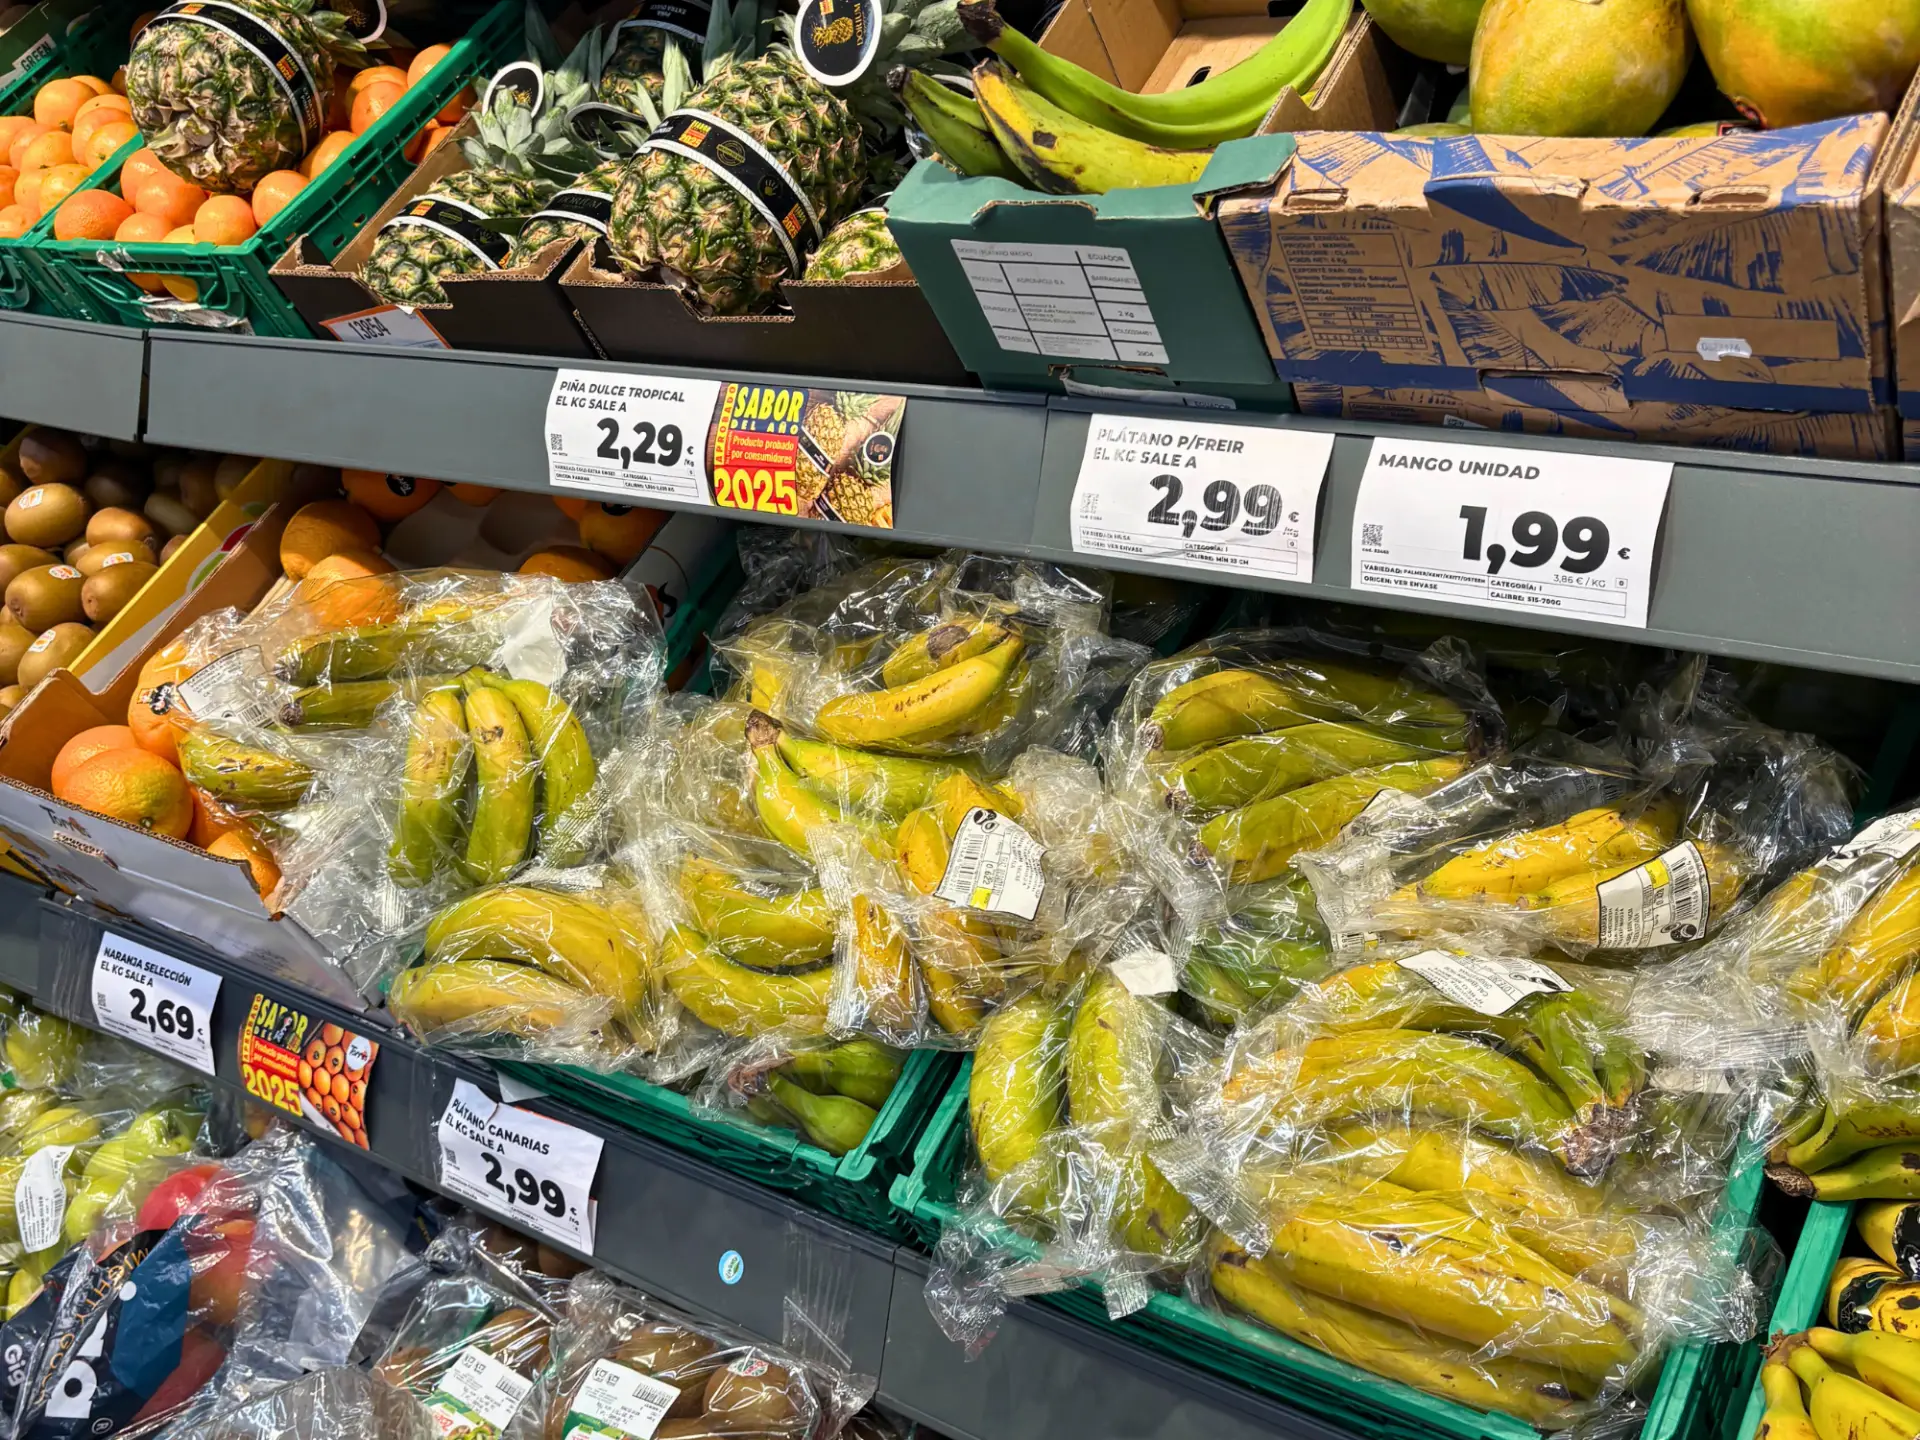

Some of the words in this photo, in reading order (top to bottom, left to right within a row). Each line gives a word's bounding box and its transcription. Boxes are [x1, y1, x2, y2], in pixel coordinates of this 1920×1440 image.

[20, 41, 52, 72] GREEN
[348, 316, 391, 340] 13854
[559, 379, 585, 393] PIÑA
[588, 383, 626, 396] DULCE
[629, 387, 685, 402] TROPICAL
[555, 395, 568, 406] EL
[570, 397, 586, 408] KG
[588, 399, 616, 411] SALE
[618, 402, 627, 412] A
[733, 386, 804, 422] SABOR
[730, 419, 756, 430] DEL
[767, 421, 799, 435] AÑO
[597, 417, 683, 470] 2,29
[687, 445, 694, 455] €
[733, 436, 764, 448] Producto
[765, 440, 794, 451] probado
[1097, 426, 1173, 446] PLÁTANO
[1177, 434, 1244, 454] P/FREIR
[731, 450, 743, 460] por
[744, 452, 792, 464] consumidores
[1093, 447, 1110, 460] EL
[1114, 449, 1137, 462] KG
[1140, 451, 1182, 467] SALE
[1184, 456, 1197, 469] A
[1378, 454, 1453, 473] MANGO
[1458, 460, 1540, 480] UNIDAD
[714, 468, 799, 516] 2025
[1148, 473, 1283, 538] 2,99
[1288, 511, 1300, 523] €
[1459, 505, 1610, 574] 1,99
[1618, 547, 1631, 560] €
[1364, 564, 1402, 574] VARIEDAD:
[1553, 574, 1574, 584] 3,86
[1575, 577, 1584, 585] €
[1591, 579, 1606, 588] KG
[1364, 576, 1392, 584] ORIGEN:
[1410, 581, 1438, 590] ENVASE
[1490, 580, 1536, 591] CATEGORÍA:
[1490, 592, 1524, 601] CALIBRE:
[100, 960, 110, 971] EL
[112, 964, 124, 976] KG
[125, 969, 146, 984] SALE
[147, 977, 153, 987] A
[104, 947, 142, 970] NARANJA
[144, 961, 192, 986] SELECCIÓN
[129, 988, 194, 1040] 2,69
[243, 1063, 303, 1117] 2025
[445, 1113, 454, 1127] EL
[455, 1122, 468, 1136] KG
[470, 1129, 494, 1150] SALE
[497, 1144, 505, 1155] A
[452, 1098, 485, 1131] PLÁTANO
[488, 1124, 550, 1155] CANARIAS
[481, 1152, 566, 1218] 2,99
